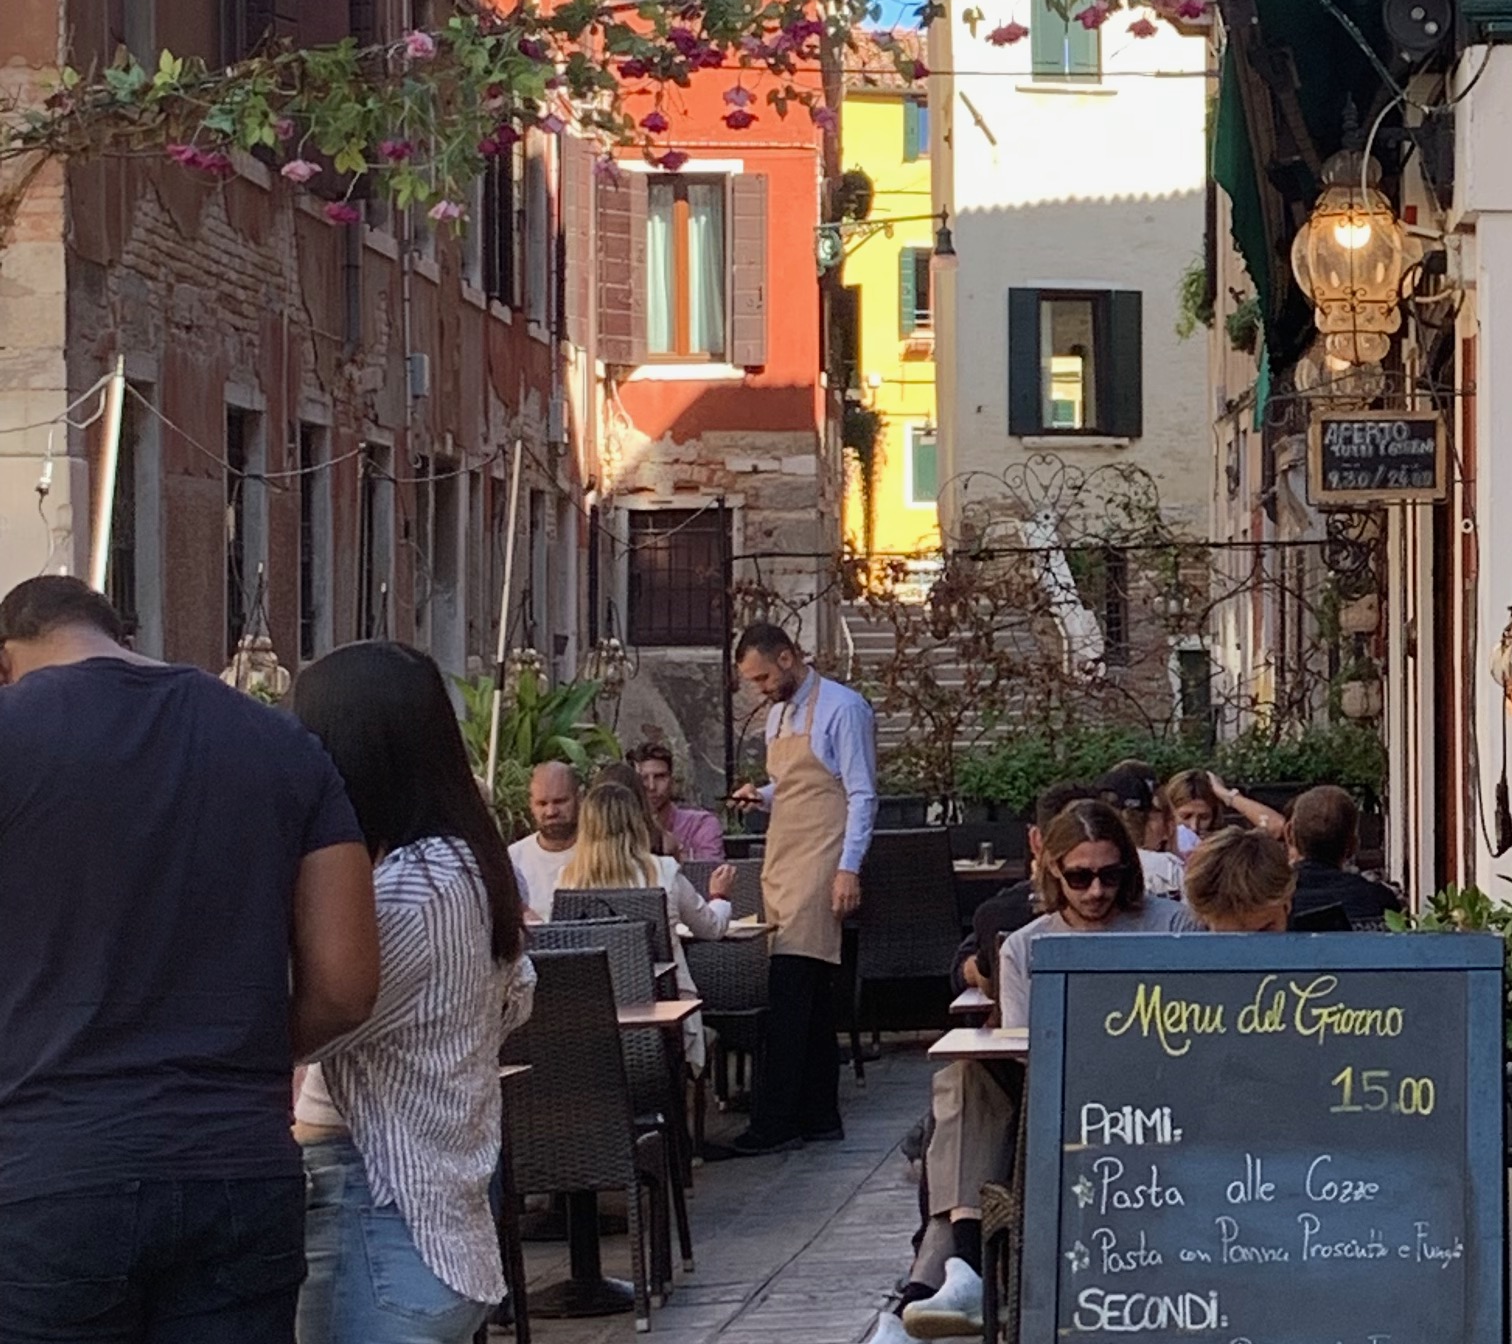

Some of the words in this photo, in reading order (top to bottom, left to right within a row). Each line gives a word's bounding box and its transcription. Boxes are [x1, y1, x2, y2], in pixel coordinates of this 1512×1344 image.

[1324, 421, 1410, 444] APERTO
[1105, 983, 1226, 1056] Menu
[1237, 974, 1286, 1036] del
[1289, 975, 1406, 1045] Giorno
[1093, 1157, 1184, 1214] Pasta
[1227, 1154, 1276, 1203] alle
[1305, 1155, 1380, 1203] Cozze
[1092, 1228, 1162, 1274] Pasta
[1179, 1248, 1211, 1262] con
